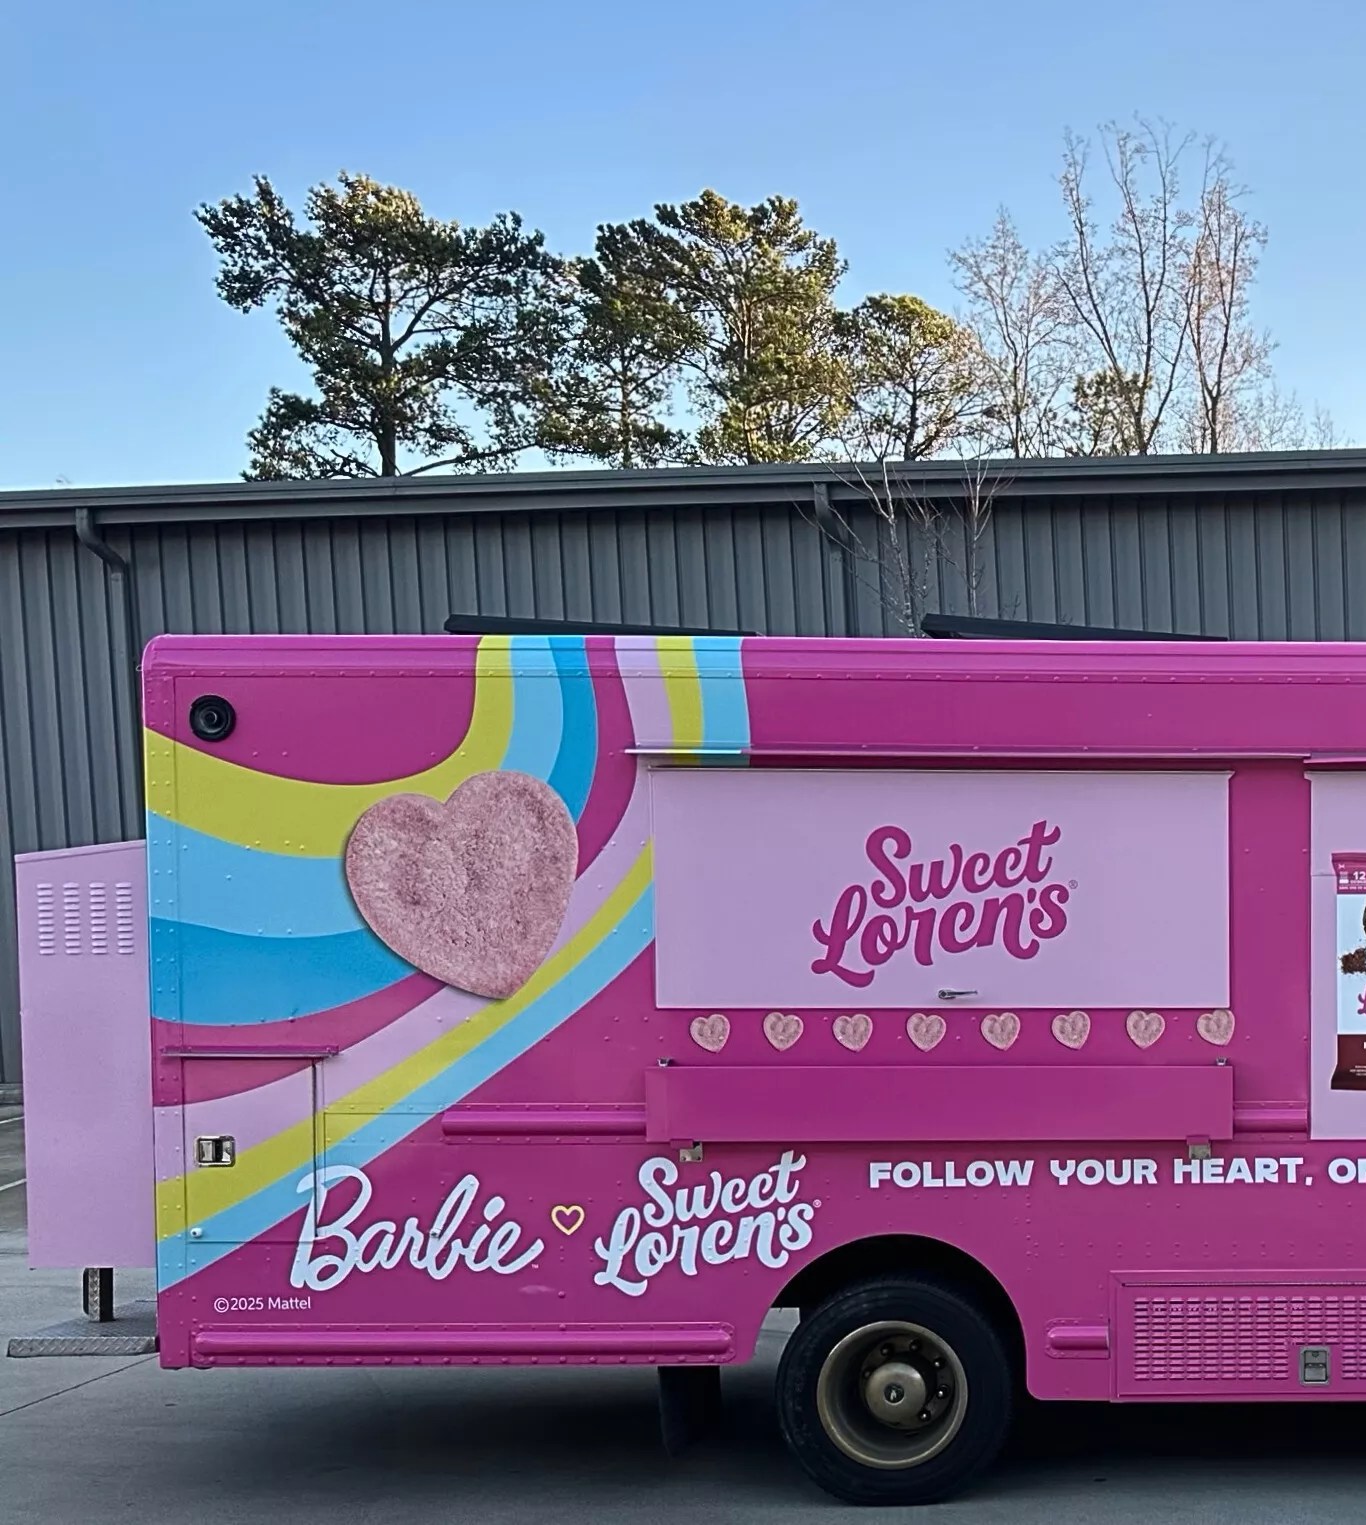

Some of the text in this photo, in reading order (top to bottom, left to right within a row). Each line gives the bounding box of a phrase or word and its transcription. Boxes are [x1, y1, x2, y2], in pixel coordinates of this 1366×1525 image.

[866, 820, 1061, 908] Sweet
[1353, 871, 1366, 880] 12
[637, 1149, 807, 1228] Sweet
[869, 1160, 1034, 1188] FOLLOW
[1050, 1159, 1158, 1186] YOUR
[1173, 1157, 1314, 1186] HEART,
[289, 1164, 544, 1291] Barbie
[213, 1296, 312, 1314] ©2025 Mattel
